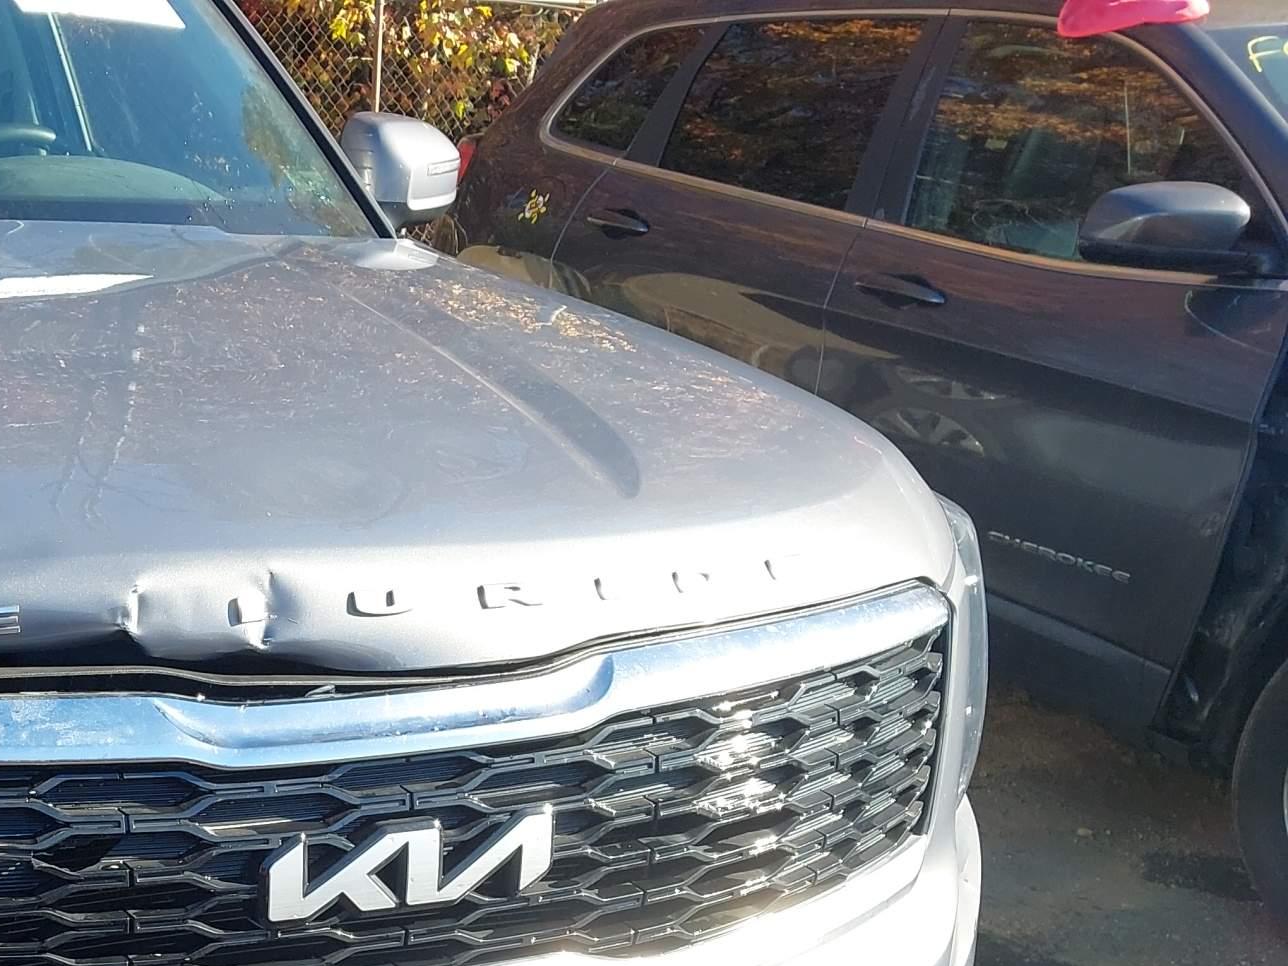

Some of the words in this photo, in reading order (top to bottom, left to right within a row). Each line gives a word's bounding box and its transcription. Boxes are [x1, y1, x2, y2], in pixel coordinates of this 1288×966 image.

[1247, 35, 1288, 73] F
[987, 530, 1132, 585] CHEROKEE
[265, 803, 555, 922] KIA
